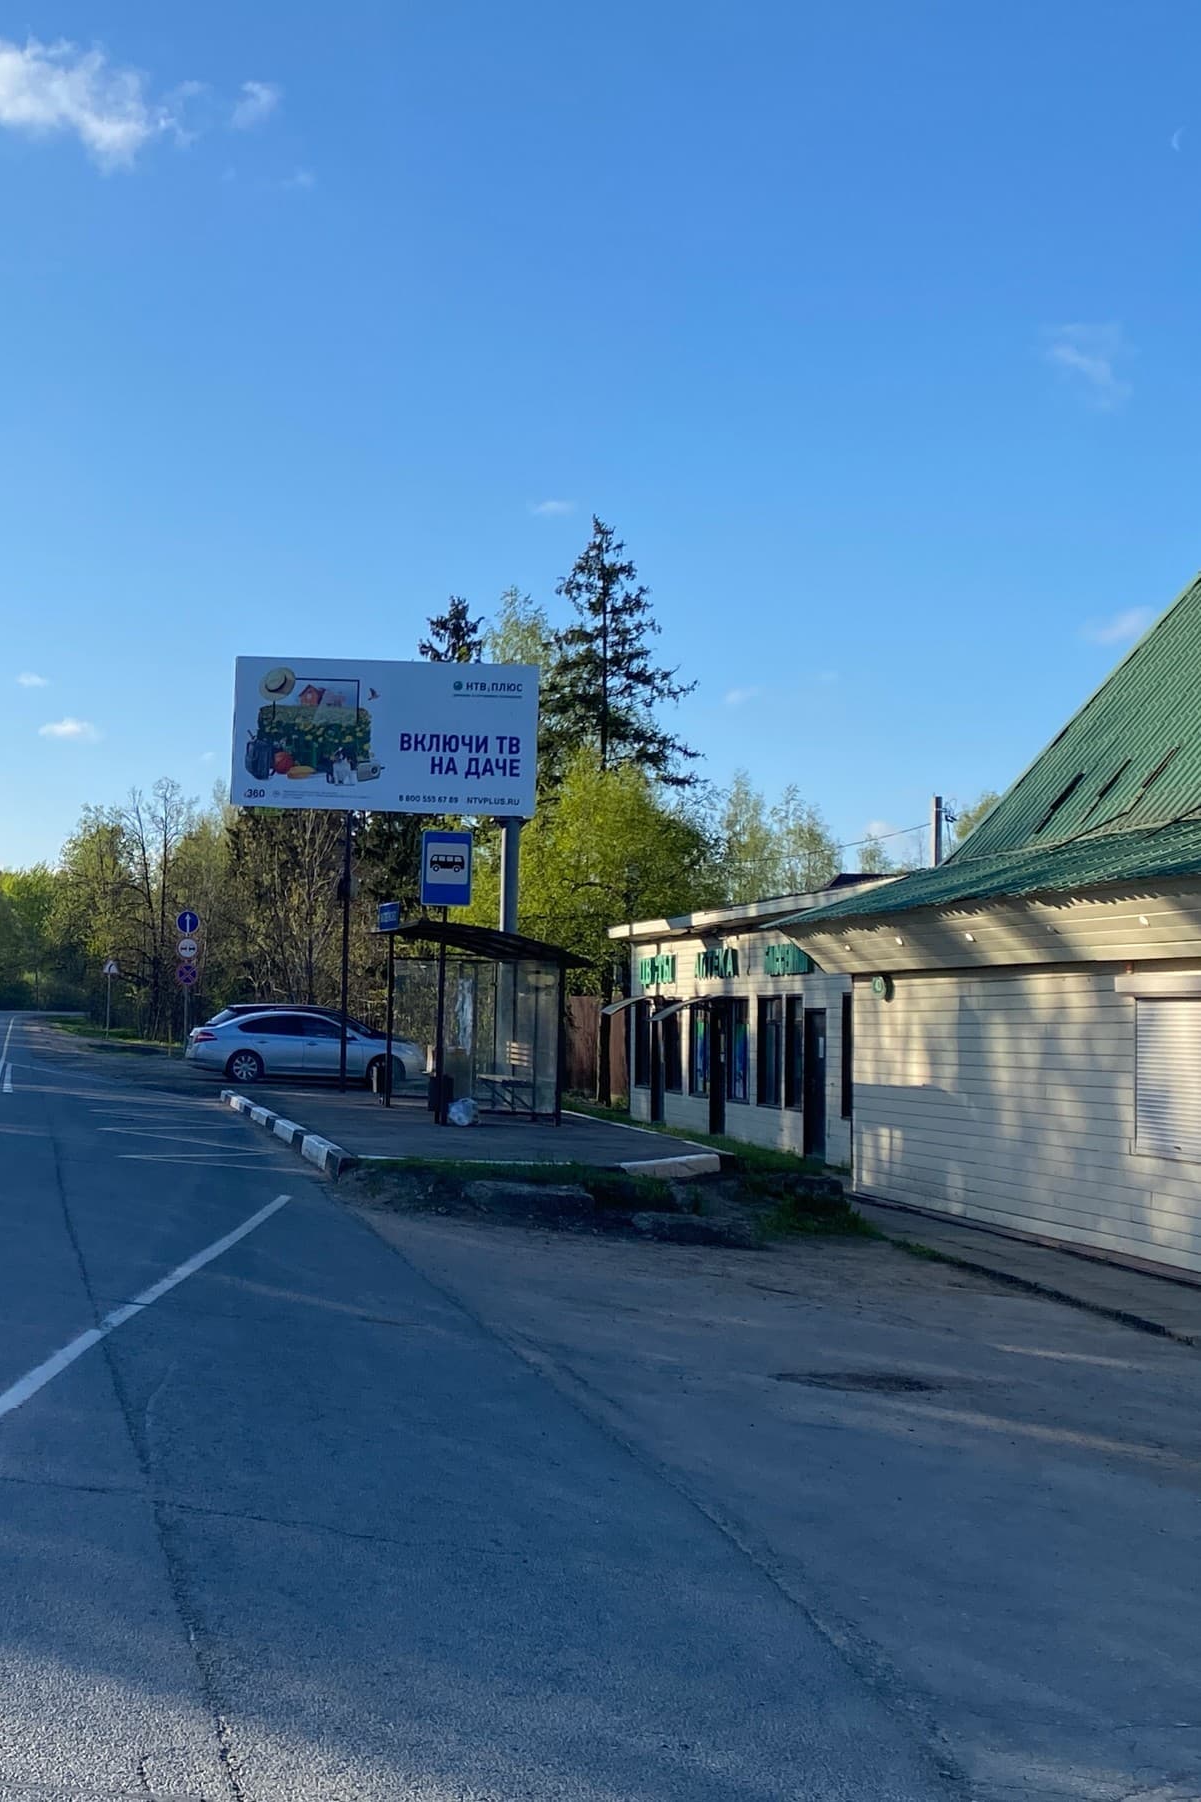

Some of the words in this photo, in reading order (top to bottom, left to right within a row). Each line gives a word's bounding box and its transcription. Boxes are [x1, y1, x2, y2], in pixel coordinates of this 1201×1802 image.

[400, 733, 488, 753] ВКЛЮЧИ
[496, 736, 520, 755] ТВ
[430, 756, 458, 775] НА
[464, 757, 521, 779] ДАЧЕ
[694, 947, 737, 978] АПТЕКА
